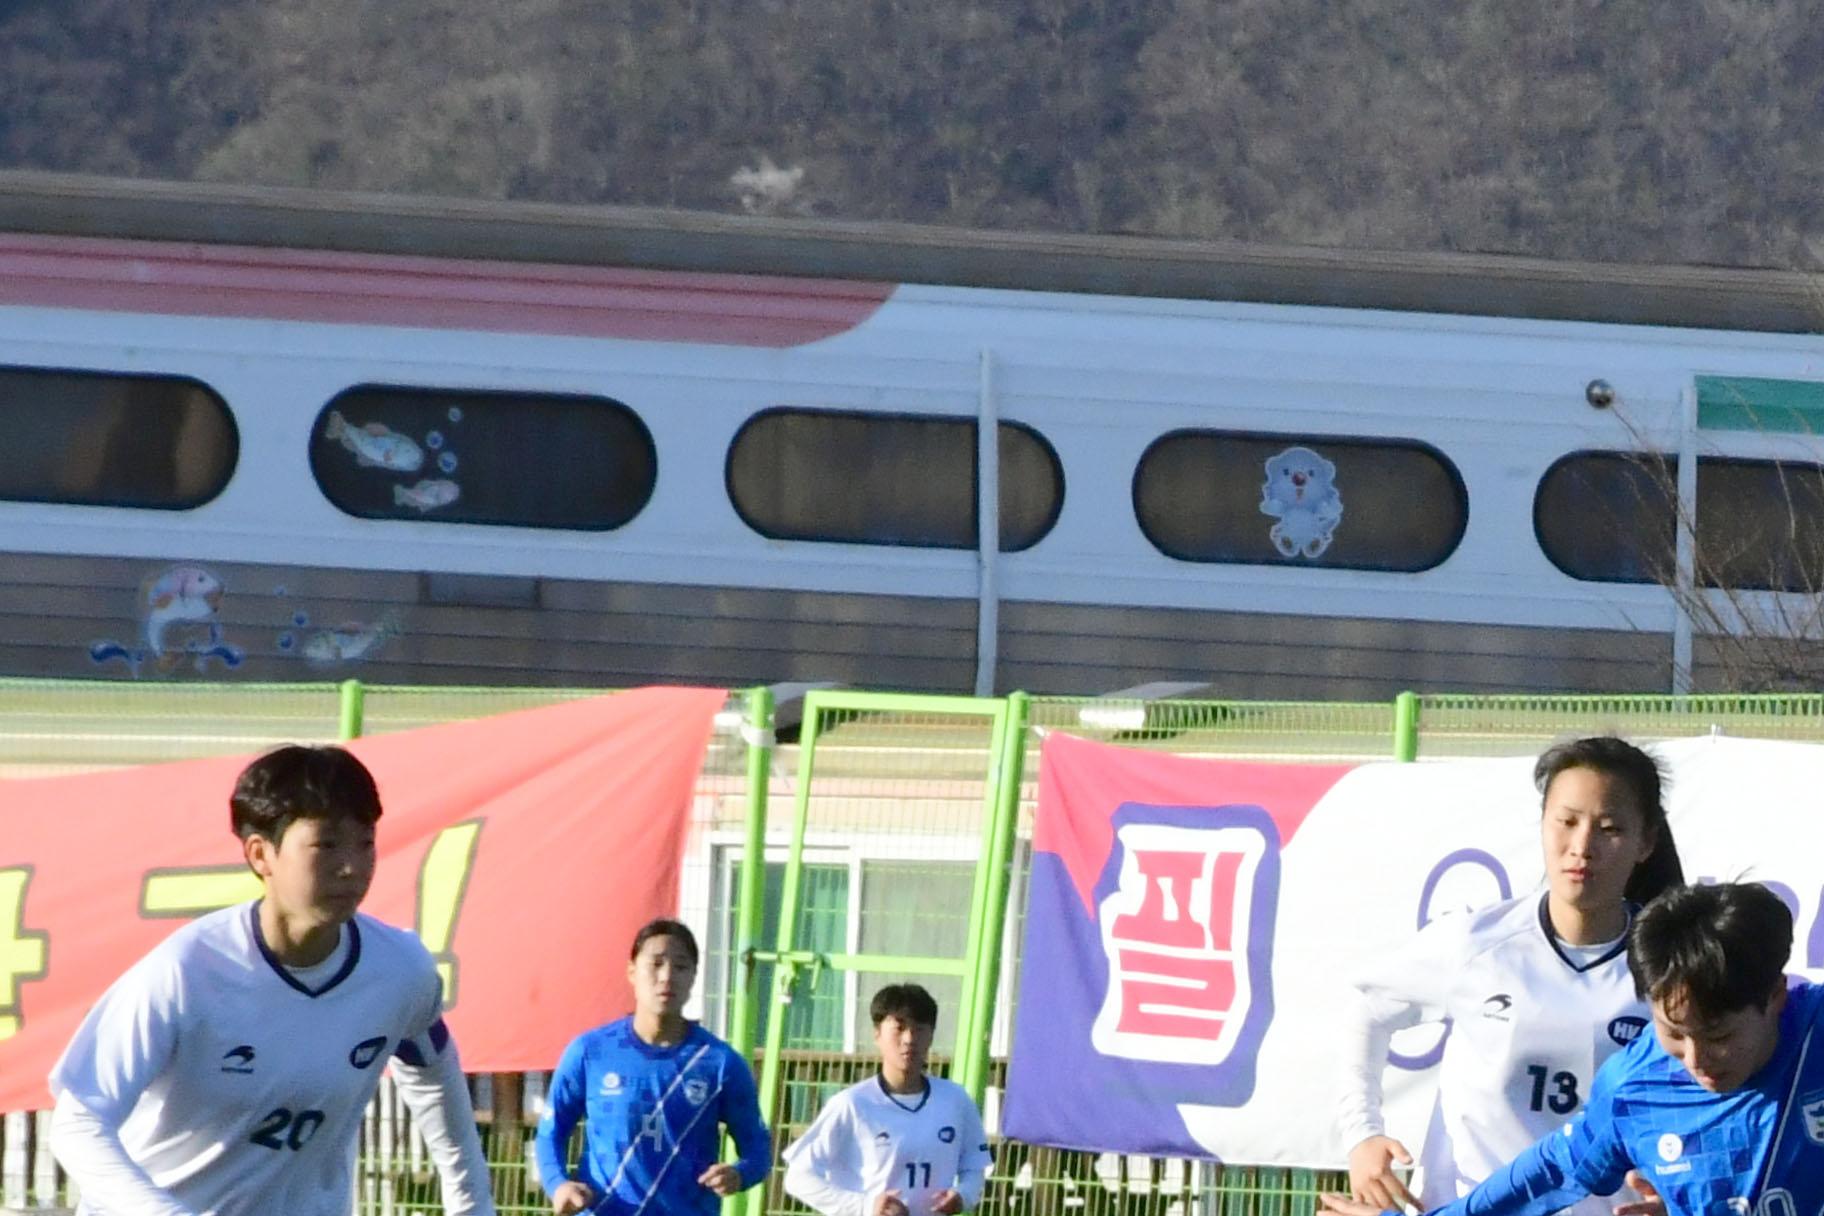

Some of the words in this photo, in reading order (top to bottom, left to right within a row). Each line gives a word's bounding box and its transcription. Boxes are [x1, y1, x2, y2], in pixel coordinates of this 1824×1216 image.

[1102, 836, 1256, 1052] 필
[1525, 1064, 1580, 1115] 13
[250, 1107, 326, 1151] 20
[641, 1107, 664, 1152] 4
[905, 1162, 931, 1189] 11
